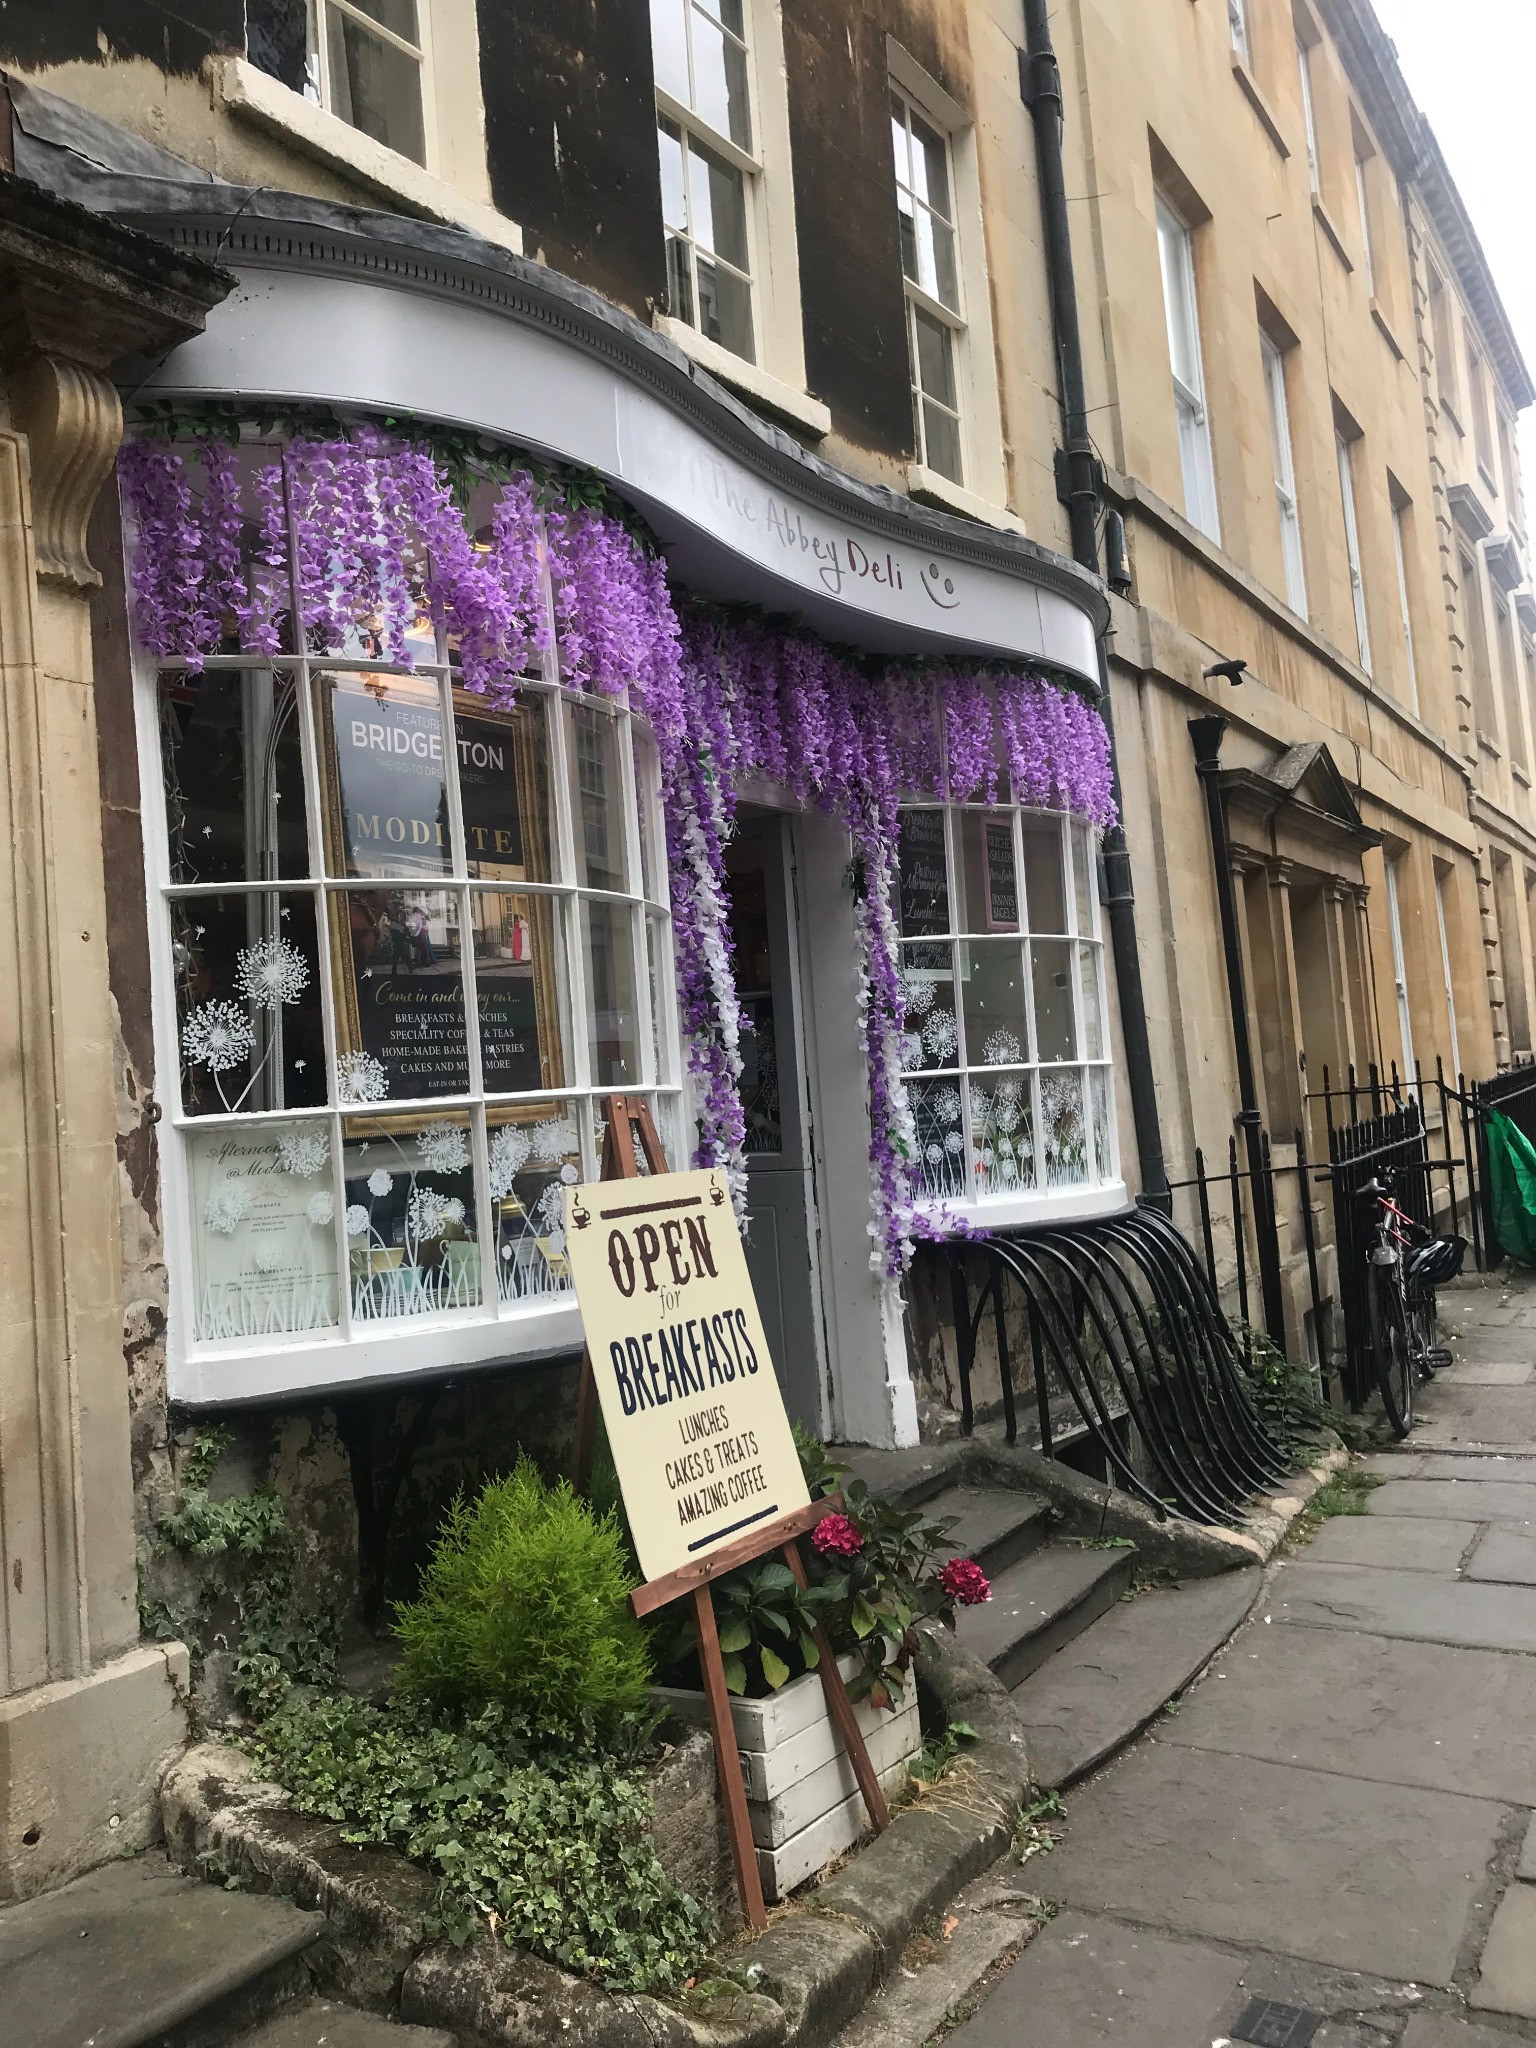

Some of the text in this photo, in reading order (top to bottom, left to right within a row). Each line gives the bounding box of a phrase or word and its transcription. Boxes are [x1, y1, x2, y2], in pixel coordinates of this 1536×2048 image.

[703, 453, 903, 594] The Abbey Deli
[396, 712, 442, 730] FEATURE
[351, 720, 504, 771] BRIDGETON
[376, 759, 393, 771] THE
[356, 813, 513, 854] MODITE
[375, 981, 411, 1005] Come
[416, 988, 428, 1003] in
[431, 986, 459, 1003] and
[460, 991, 490, 1012] eoy
[390, 1029, 444, 1040] SPECIALITY
[484, 1029, 491, 1038] &
[492, 1028, 515, 1038] TEAS
[395, 1012, 507, 1024] BREAKFASTS & NCHES
[382, 1045, 441, 1057] HOME-MADE
[443, 1044, 468, 1055] BAKE
[401, 1062, 432, 1074] CAKES
[435, 1061, 454, 1072] AND
[486, 1059, 511, 1070] MORE
[207, 1139, 282, 1164] Afternoon
[608, 1215, 719, 1297] OPEN
[659, 1285, 681, 1319] for
[610, 1308, 758, 1416] BREAKFASTS
[678, 1405, 729, 1445] LUNCHES
[665, 1431, 758, 1490] CAKES & TREATS
[677, 1464, 767, 1526] AMAZING COFFEE
